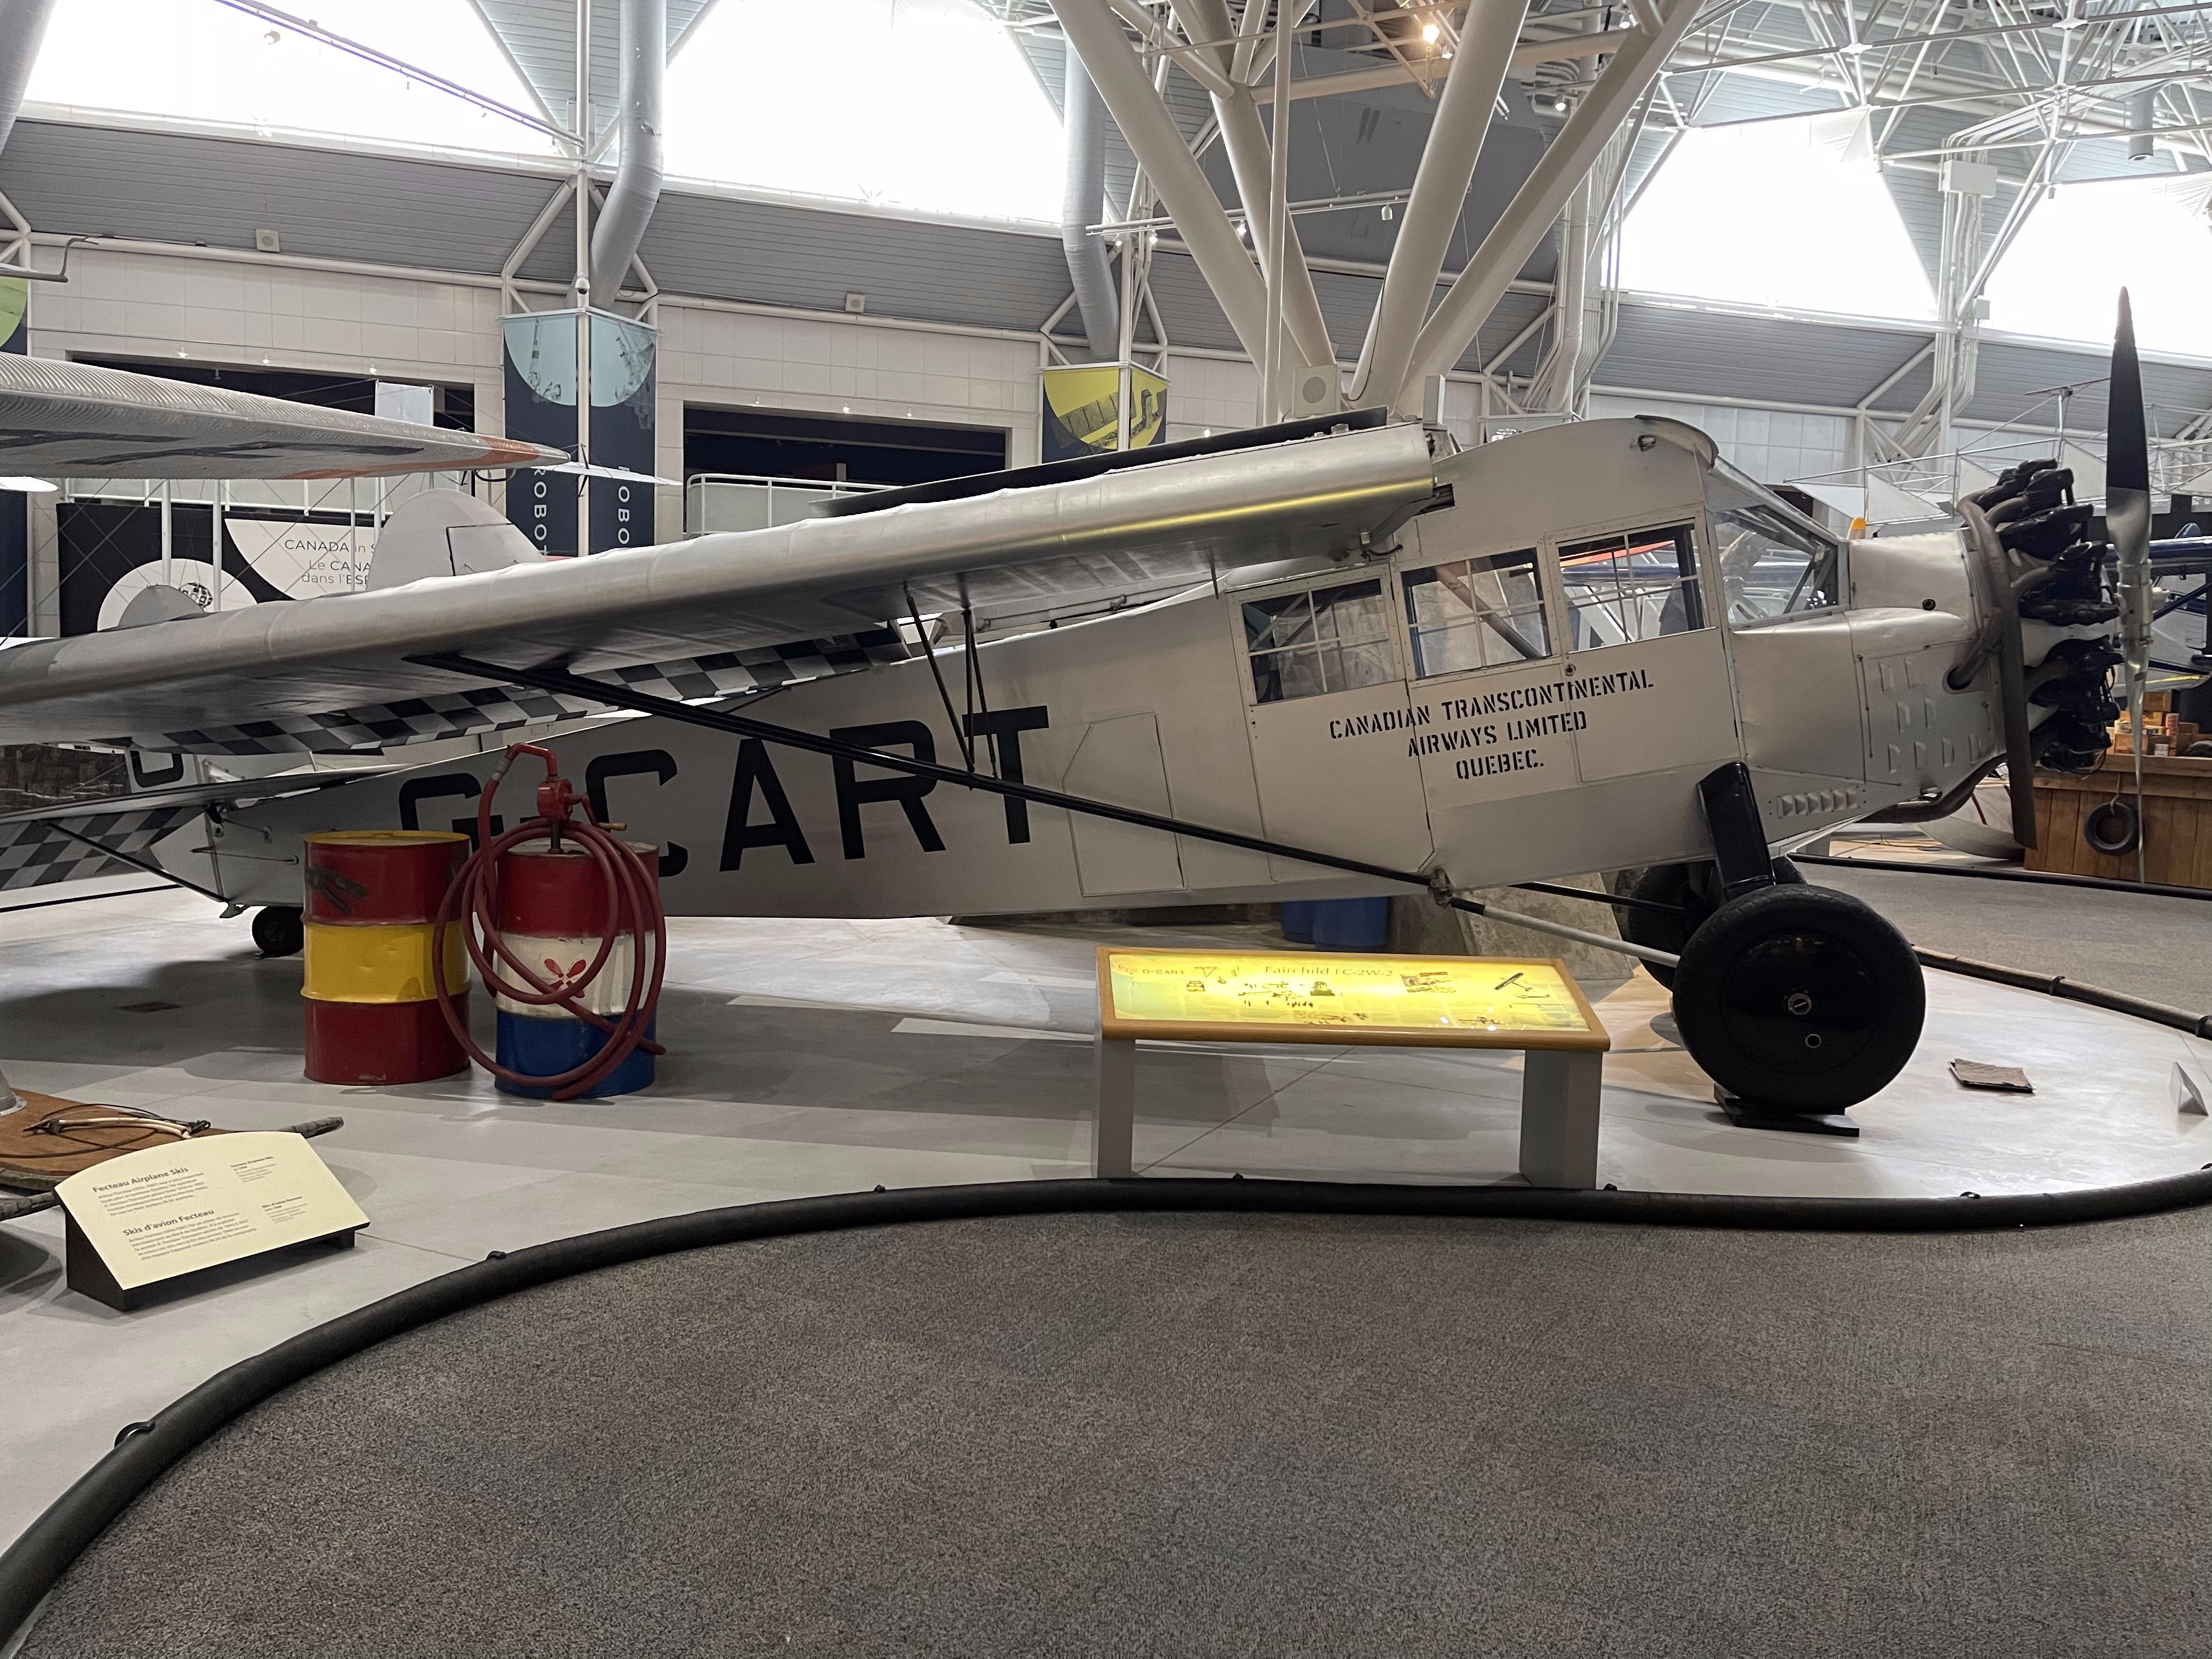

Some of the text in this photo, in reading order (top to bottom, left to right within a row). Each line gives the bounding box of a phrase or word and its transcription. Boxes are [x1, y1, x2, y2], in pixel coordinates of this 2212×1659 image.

[285, 539, 349, 552] CANADA
[355, 543, 366, 553] in
[302, 572, 334, 584] dans
[309, 560, 325, 570] Le
[1329, 669, 1654, 740] CANADIAN TRANSCONTINENTAL
[1408, 710, 1588, 757] AIRWAYS LIMITED
[1456, 748, 1544, 780] QUEBEC.
[1265, 966, 1329, 975] Fairchild
[92, 1180, 129, 1193] Fecteau
[131, 1172, 170, 1183] Airplane
[170, 1166, 189, 1176] Skis
[122, 1227, 143, 1237] Skis
[144, 1218, 178, 1231] d'avion
[178, 1209, 215, 1222] Fecteau
